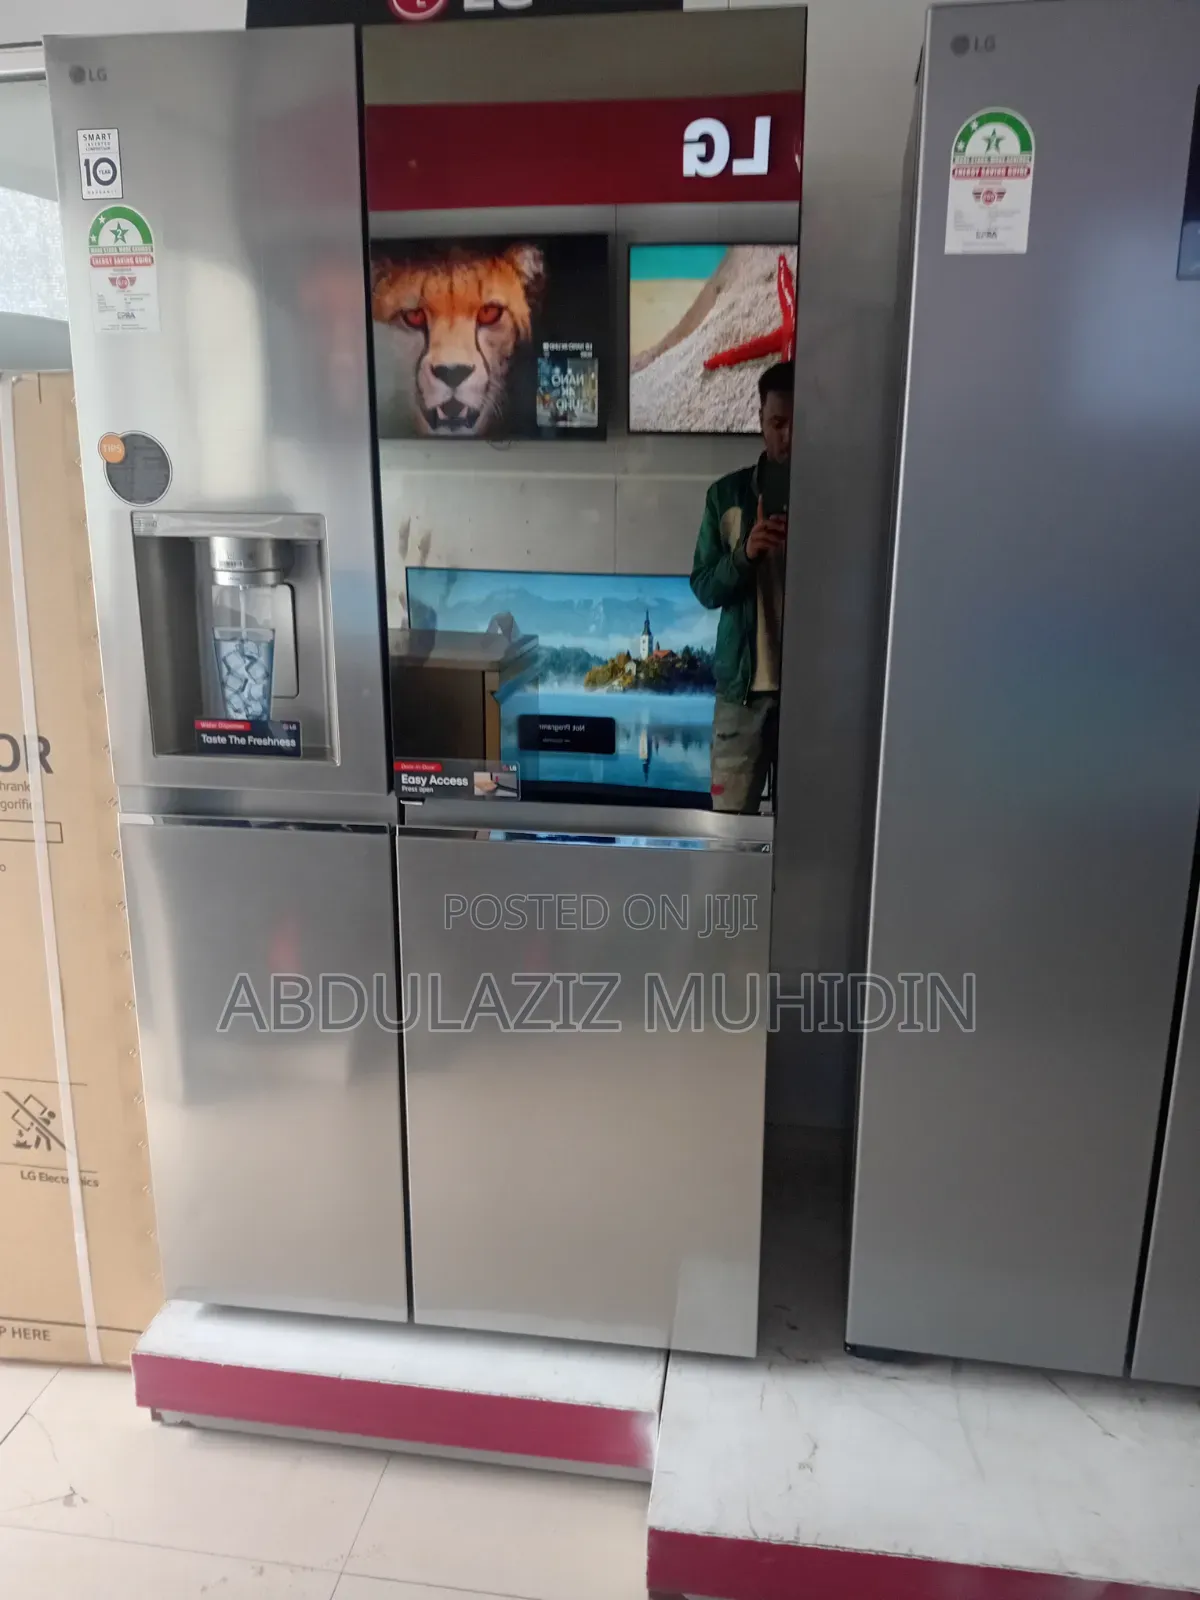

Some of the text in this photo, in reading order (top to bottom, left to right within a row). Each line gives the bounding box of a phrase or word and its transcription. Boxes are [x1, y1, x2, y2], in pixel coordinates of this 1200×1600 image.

[88, 67, 107, 82] LG
[82, 133, 112, 141] SMART
[84, 157, 117, 186] 10
[116, 229, 123, 239] 2
[103, 443, 121, 453] TIPS
[201, 733, 297, 747] Taste The Freshness
[509, 764, 517, 772] LG
[401, 773, 469, 787] Easy Access
[401, 785, 418, 793] Press
[20, 1170, 36, 1181] LG
[11, 1326, 52, 1342] HERE
